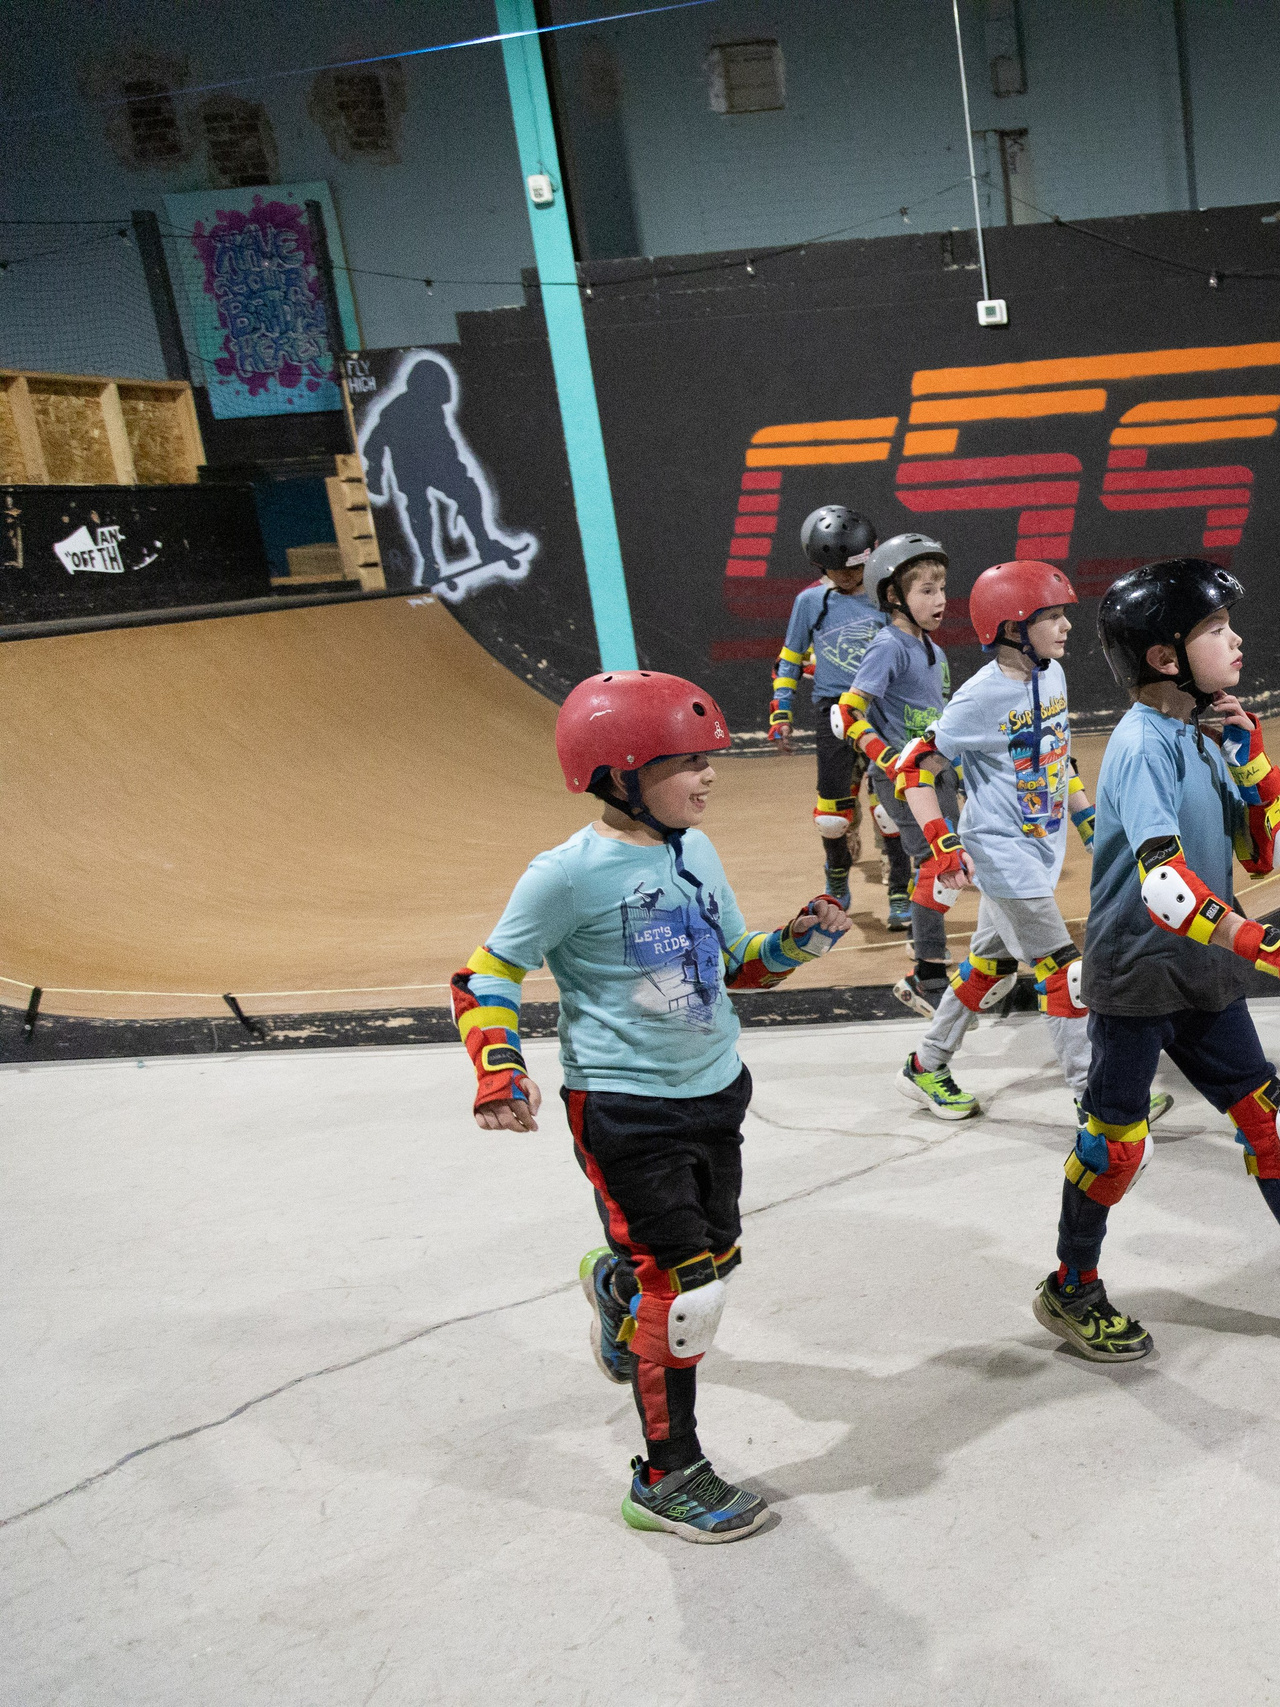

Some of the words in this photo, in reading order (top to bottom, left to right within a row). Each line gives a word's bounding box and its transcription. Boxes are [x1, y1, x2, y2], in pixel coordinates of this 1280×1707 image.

[346, 360, 370, 376] FLY
[348, 376, 377, 393] HIGH
[634, 926, 672, 943] LET'S
[653, 934, 690, 955] RIDE
